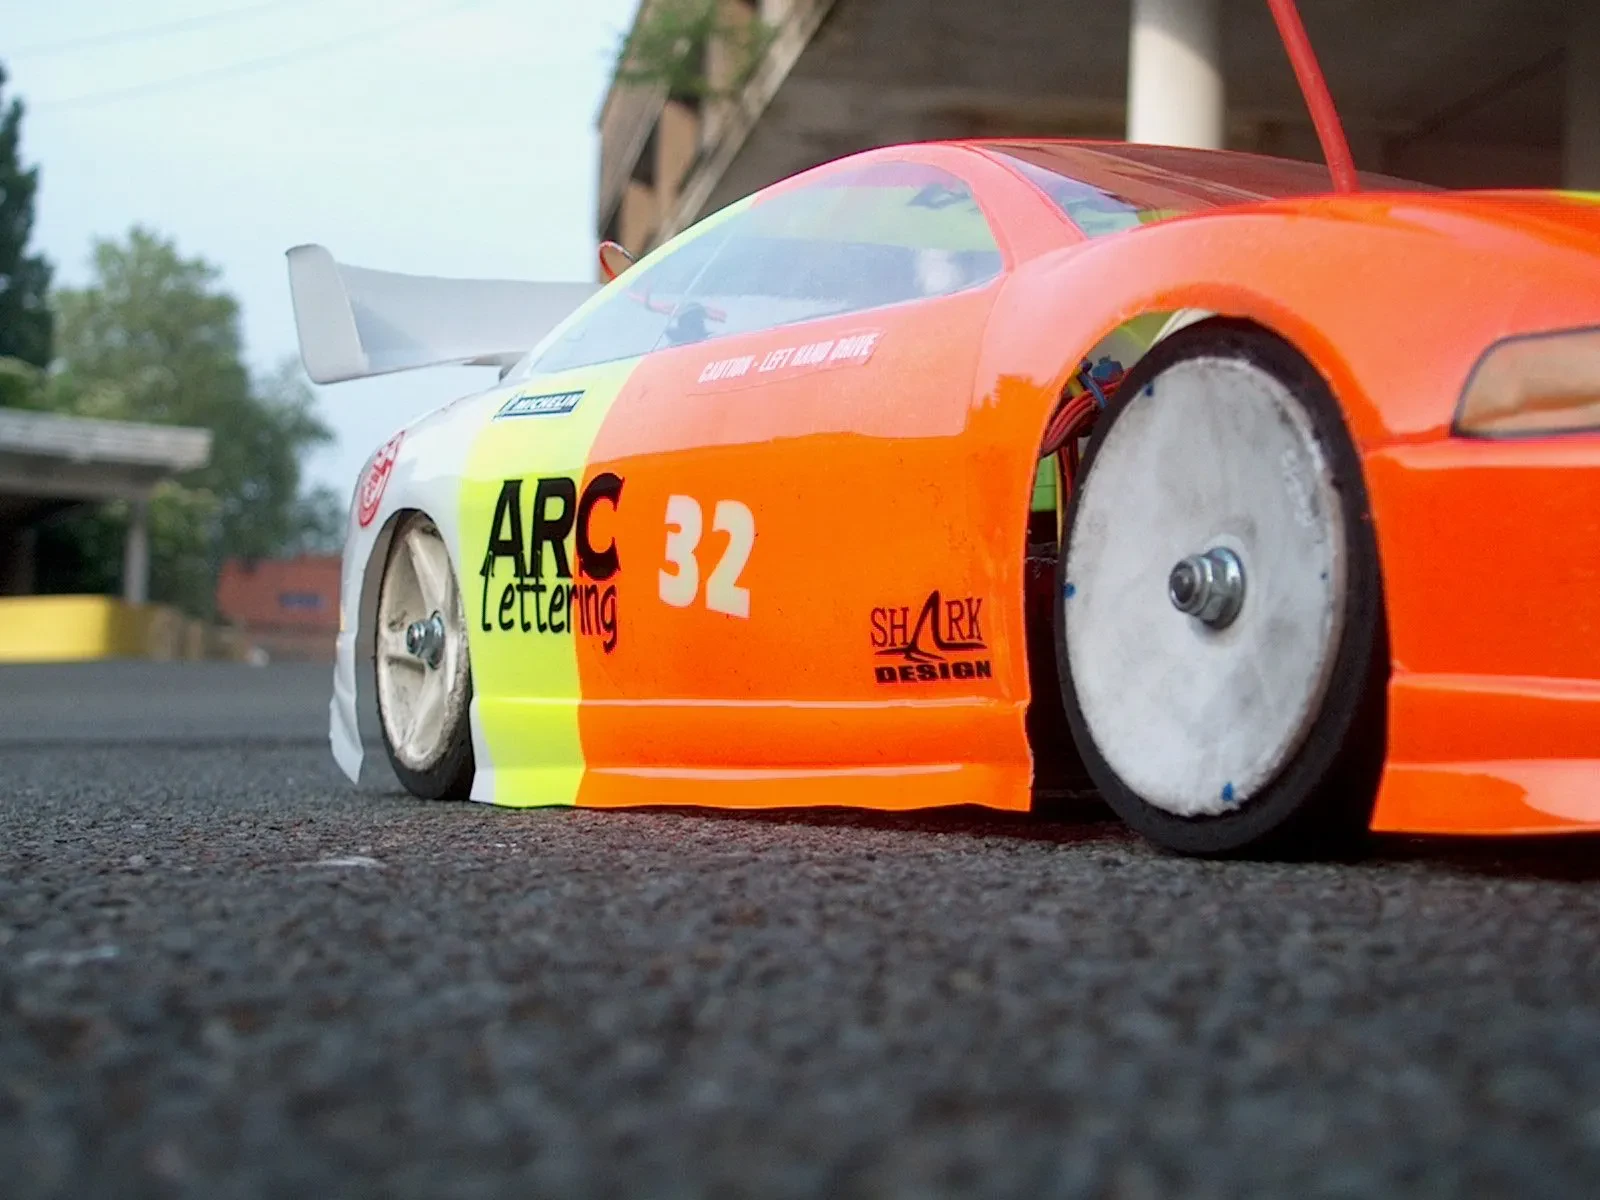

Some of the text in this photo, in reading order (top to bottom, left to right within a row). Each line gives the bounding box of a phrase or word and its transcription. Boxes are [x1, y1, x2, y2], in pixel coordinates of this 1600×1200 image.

[758, 348, 797, 373] LEFT
[791, 340, 835, 367] HAND
[830, 332, 880, 361] DRIVE
[480, 472, 625, 582] ARC
[659, 494, 755, 619] 32
[870, 589, 986, 658] SHARK
[874, 660, 992, 684] DESIGN
